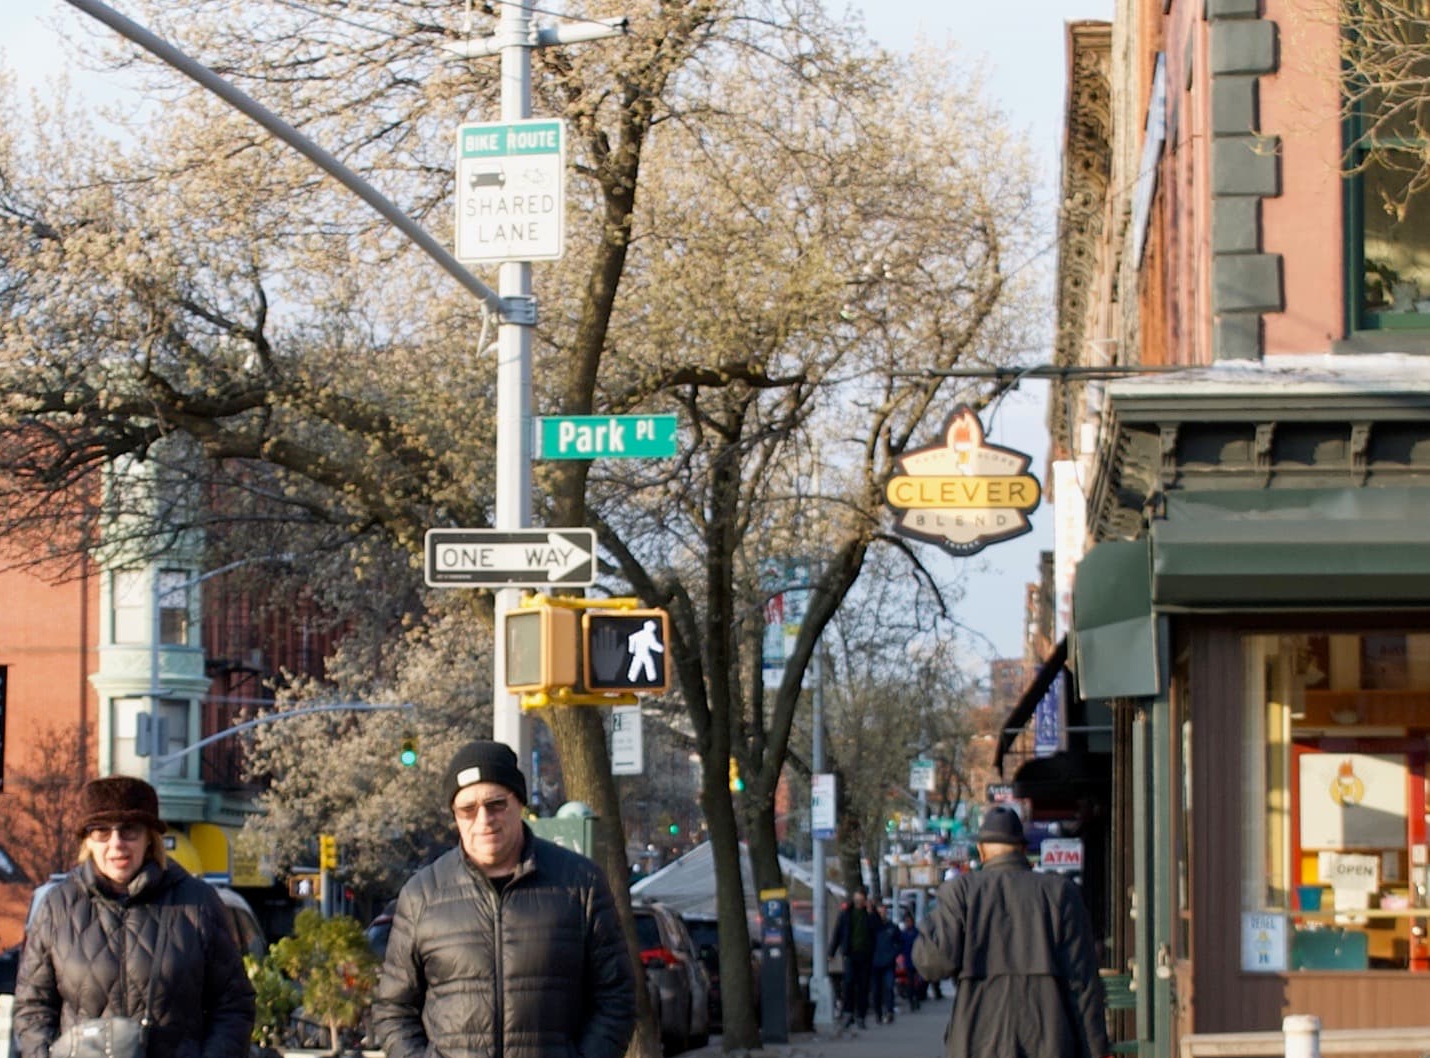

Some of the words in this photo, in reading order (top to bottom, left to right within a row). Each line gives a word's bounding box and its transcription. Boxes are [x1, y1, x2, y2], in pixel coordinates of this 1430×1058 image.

[465, 133, 499, 152] BIKE
[507, 130, 557, 149] ROUTE
[465, 194, 554, 217] SHARED
[478, 222, 539, 243] LANE
[559, 420, 625, 453] Park
[636, 420, 656, 440] Pl
[895, 482, 1026, 502] CLEVER
[916, 515, 1006, 526] BLEND
[442, 548, 494, 567] ONE
[525, 548, 575, 567] WAY
[1044, 851, 1082, 865] ATM
[1336, 863, 1373, 876] OPEN
